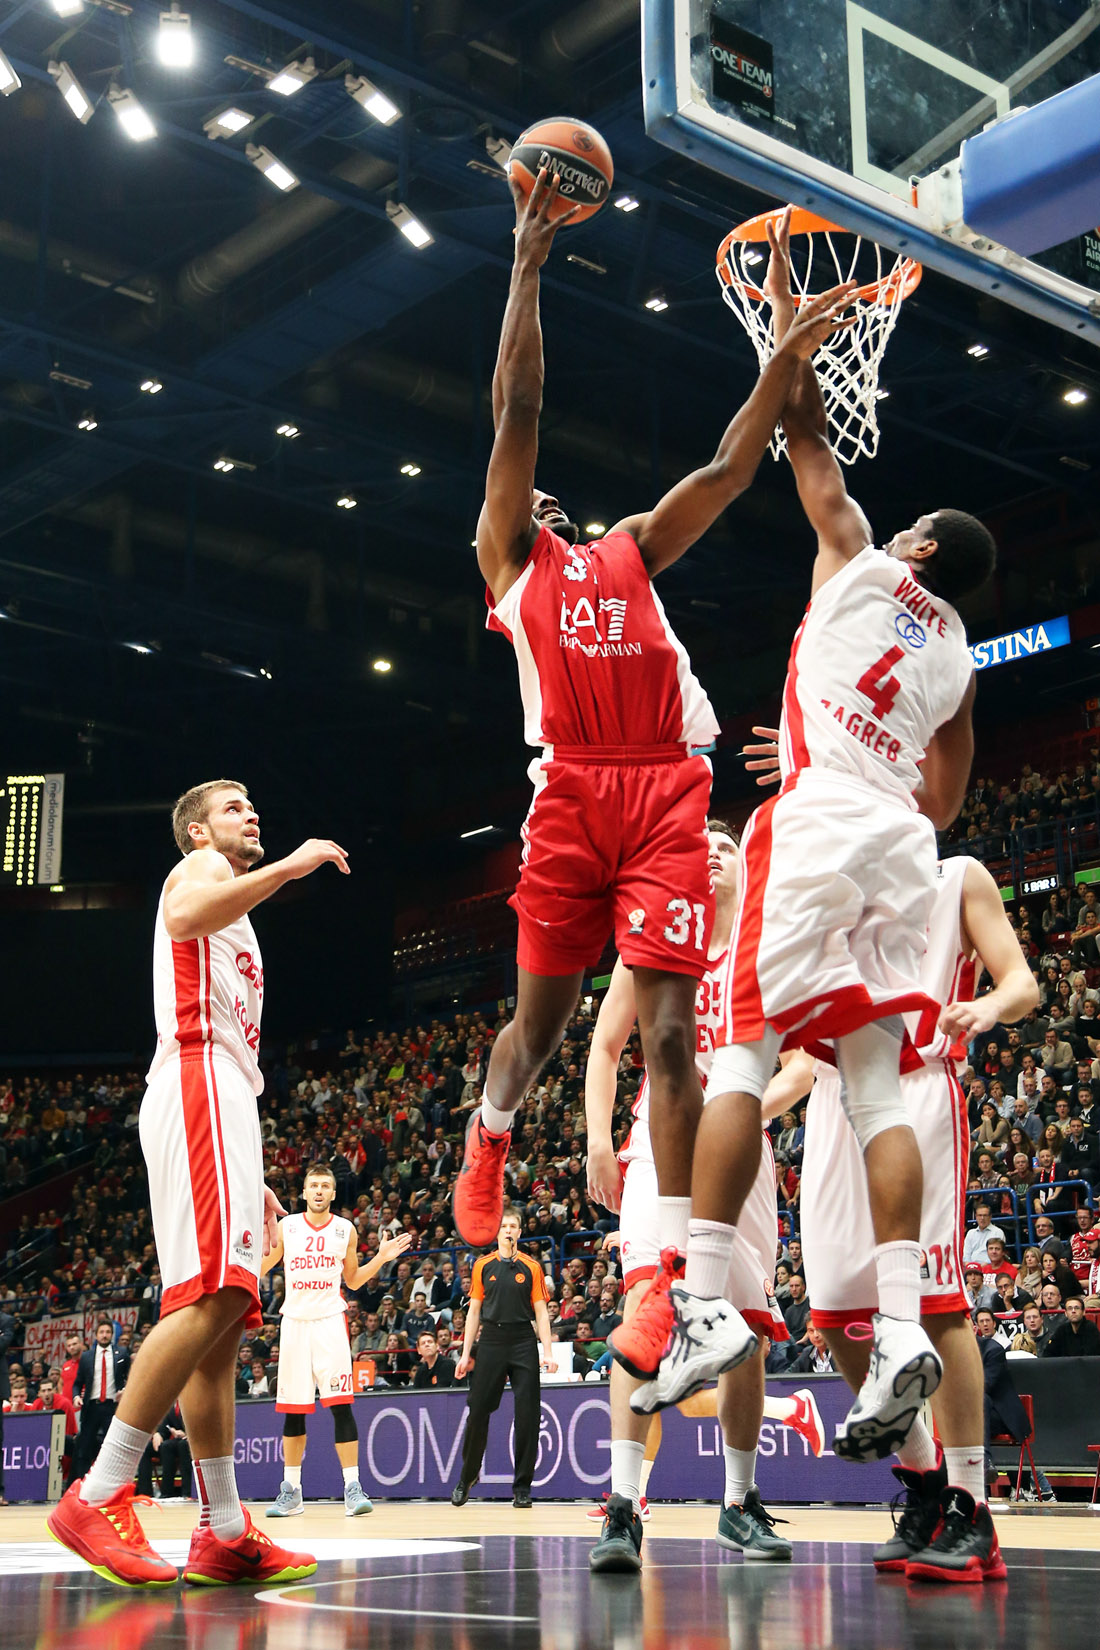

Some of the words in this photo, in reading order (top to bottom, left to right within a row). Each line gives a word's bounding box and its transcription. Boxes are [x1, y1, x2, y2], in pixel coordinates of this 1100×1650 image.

[712, 46, 738, 71] ONE
[740, 59, 772, 87] TEAM
[536, 149, 605, 200] SPALDING
[1084, 235, 1100, 252] TU
[893, 576, 949, 639] WHITE
[598, 642, 643, 658] ARMANI
[856, 644, 906, 722] 4
[1030, 879, 1050, 892] BAR
[663, 898, 706, 950] 31
[305, 1236, 325, 1252] 20
[290, 1254, 337, 1272] CEDEVITA
[292, 1280, 333, 1290] KONZUM
[998, 1323, 1025, 1342] A21
[357, 1369, 370, 1389] 5
[697, 1423, 848, 1457] LISTY
[233, 1437, 306, 1464] GISTI
